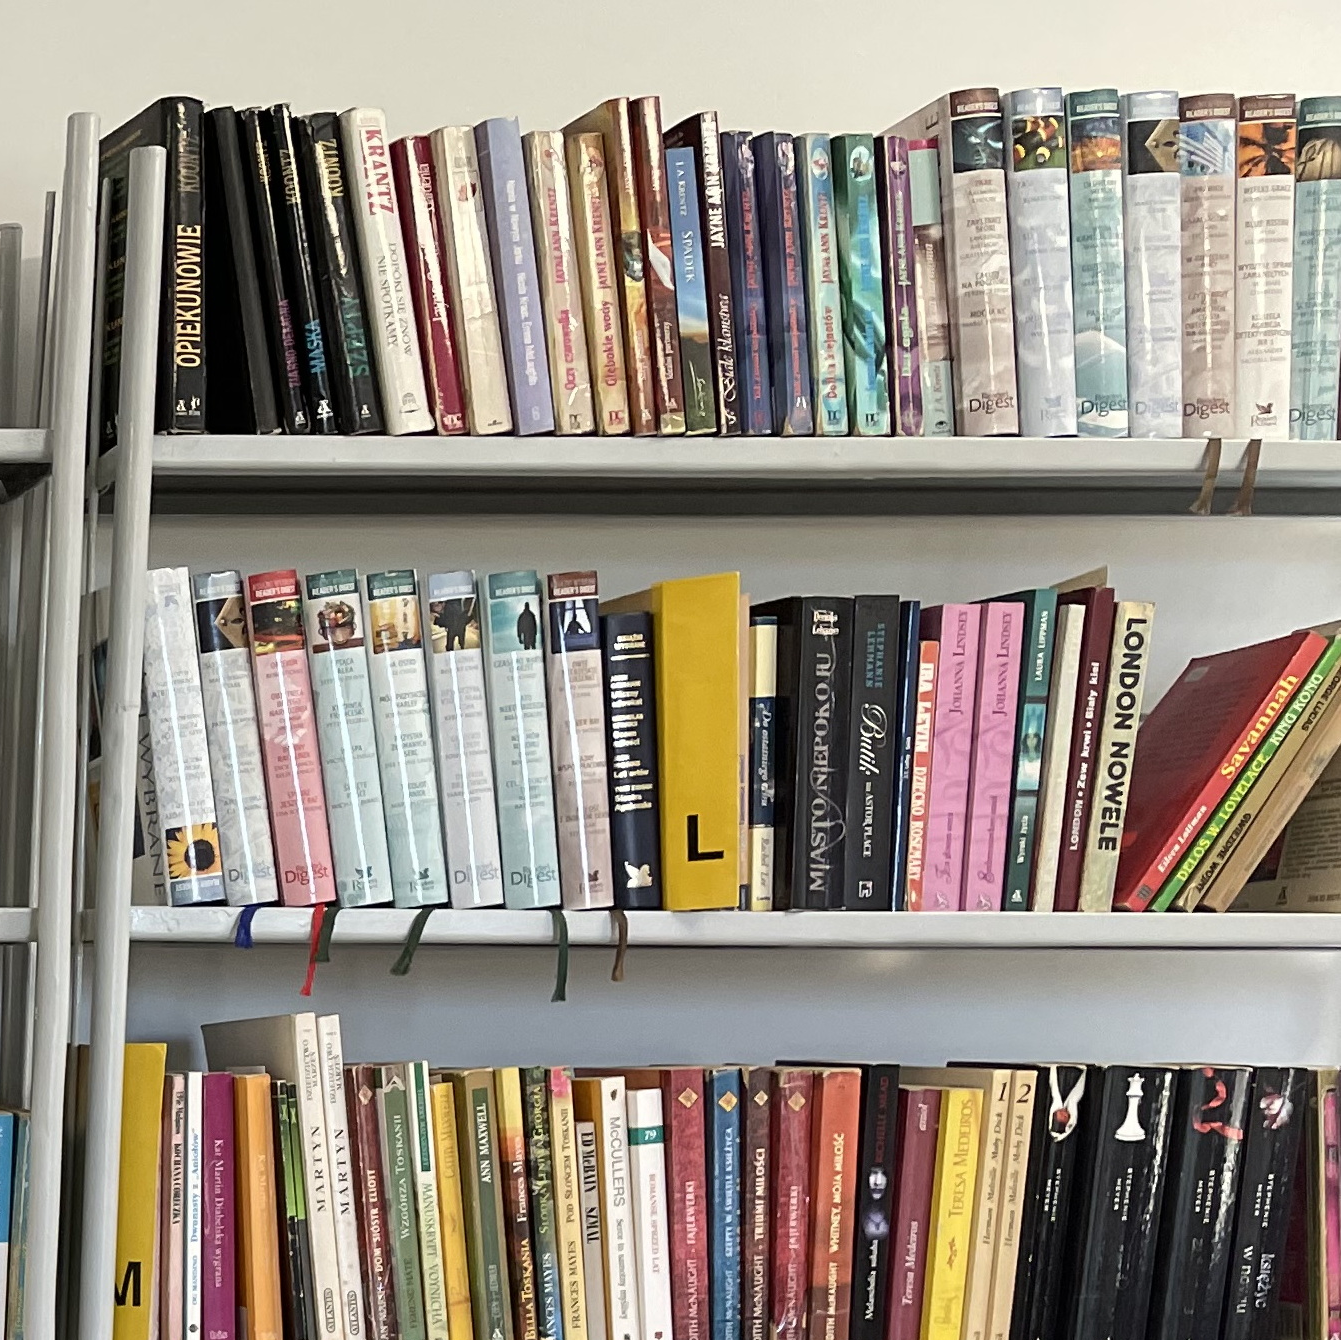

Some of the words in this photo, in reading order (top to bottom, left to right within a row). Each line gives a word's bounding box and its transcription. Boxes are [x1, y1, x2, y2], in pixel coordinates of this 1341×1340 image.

[177, 225, 201, 366] OPIEKUNOWIE
[1120, 618, 1146, 730] LONDON
[1220, 674, 1299, 779] Savannah
[687, 815, 724, 861] L
[1099, 742, 1129, 851] NOWELE
[313, 1125, 328, 1212] MARTYN
